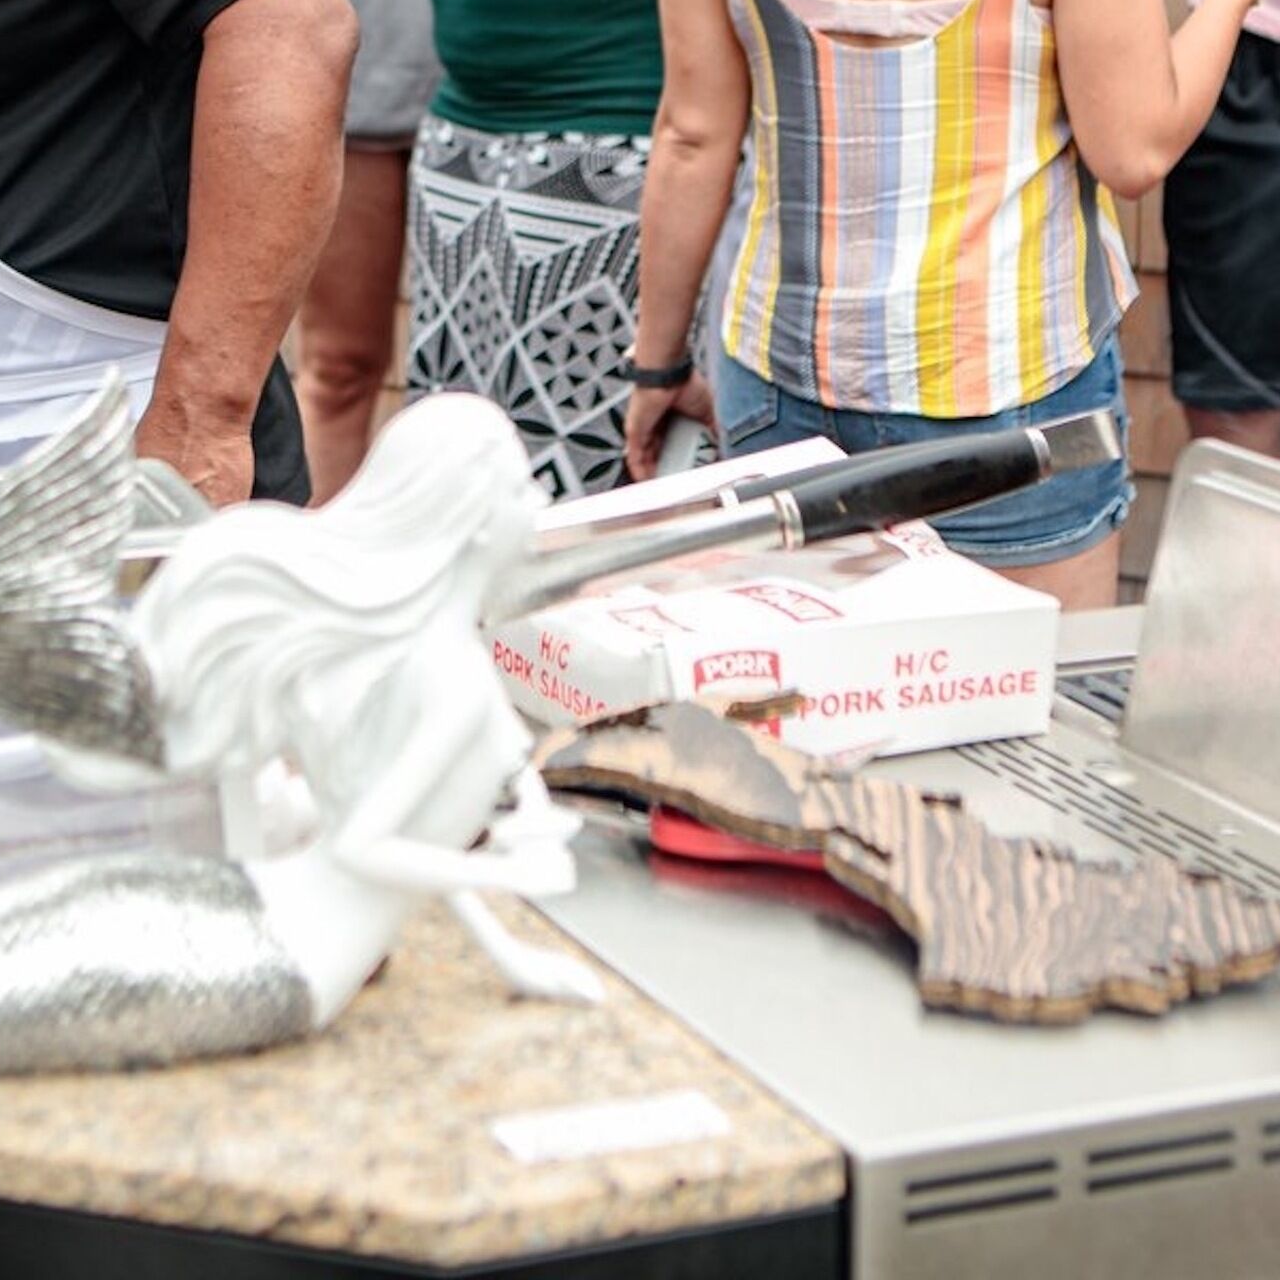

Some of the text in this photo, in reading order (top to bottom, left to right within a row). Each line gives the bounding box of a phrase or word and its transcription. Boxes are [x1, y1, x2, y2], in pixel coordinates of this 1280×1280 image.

[540, 631, 570, 670] H/C
[702, 653, 772, 682] PORK
[895, 650, 950, 677] H/C
[493, 640, 609, 718] PORK SAUSA
[798, 671, 1037, 720] PORK SAUSAGE
